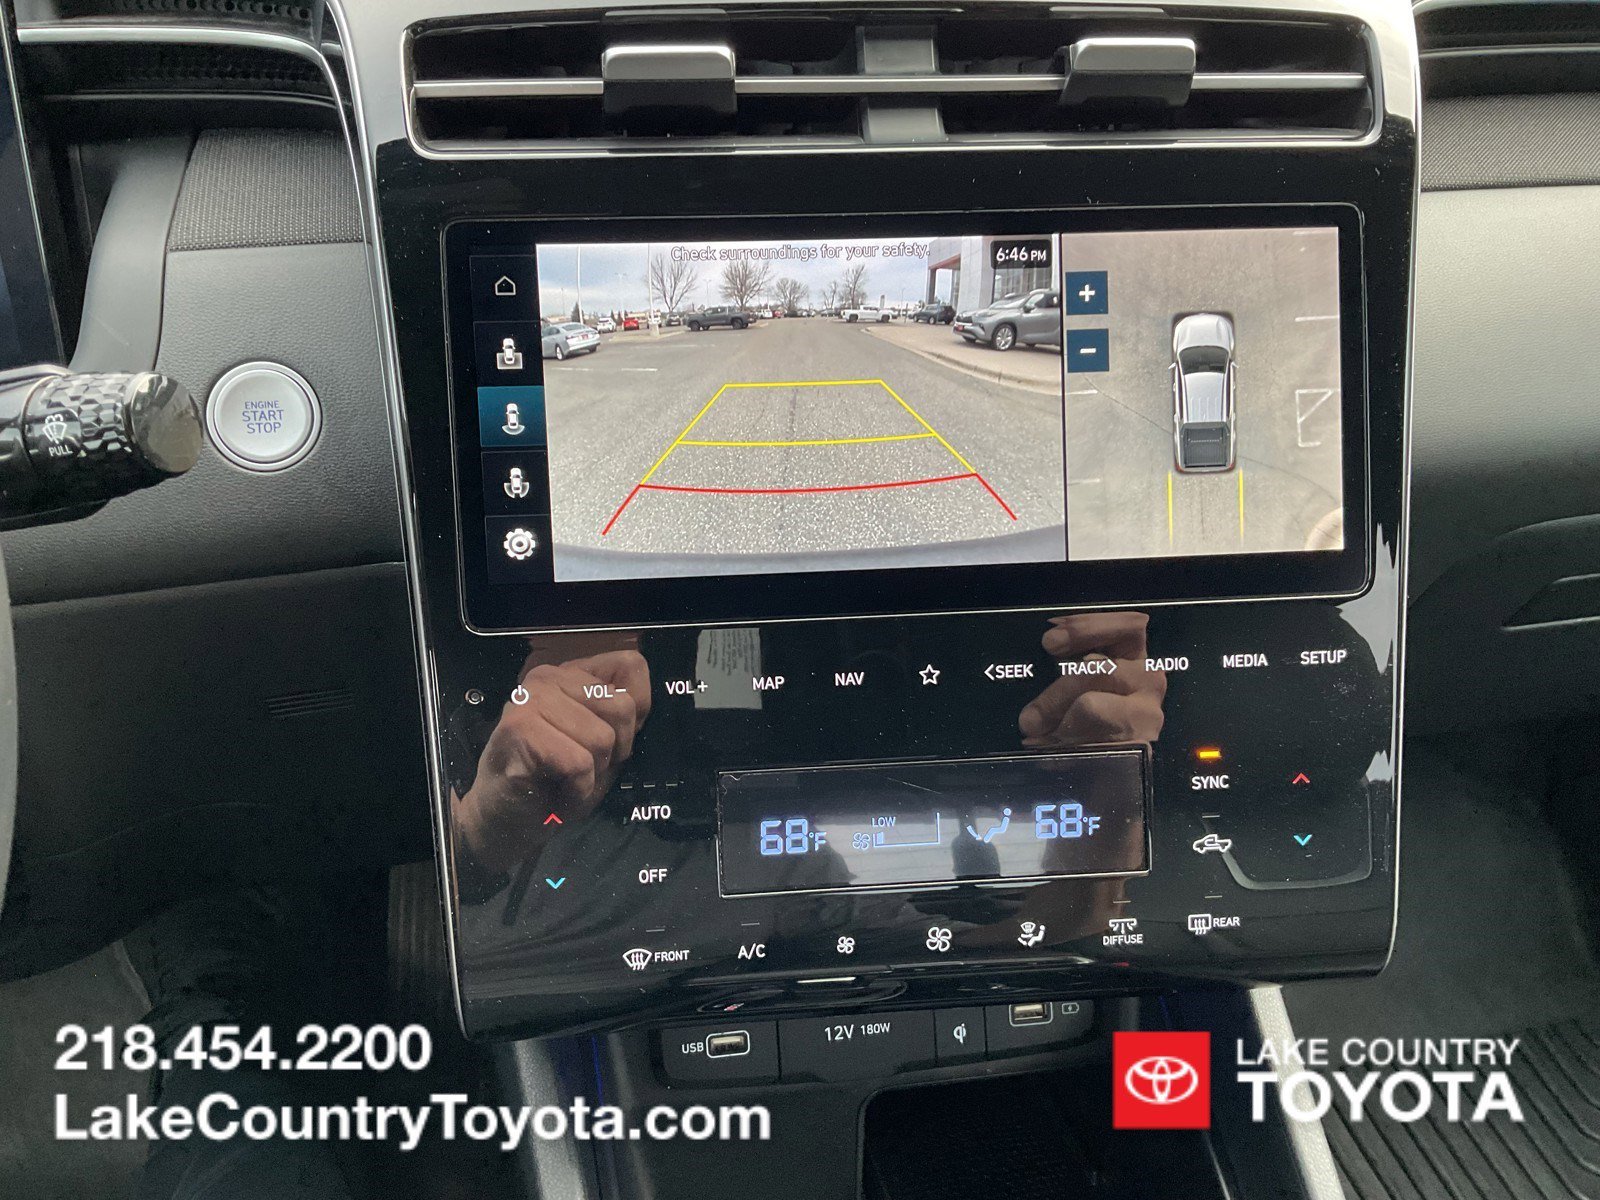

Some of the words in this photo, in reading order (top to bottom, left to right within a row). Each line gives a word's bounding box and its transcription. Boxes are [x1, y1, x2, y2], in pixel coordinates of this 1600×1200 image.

[671, 246, 717, 262] Check
[719, 245, 818, 264] surroundings
[820, 243, 842, 260] for
[845, 244, 878, 262] your
[881, 242, 931, 261] safety.
[996, 246, 1028, 262] 6:46
[1030, 249, 1047, 262] PM
[244, 400, 280, 409] ENGINE
[242, 410, 284, 422] START
[246, 421, 282, 433] STOP
[49, 445, 73, 457] PULL
[1145, 657, 1189, 672] RADIO
[1222, 654, 1268, 669] MEDIA
[1300, 649, 1346, 665] SETUP
[752, 676, 785, 691] MAP
[834, 671, 865, 687] NAV
[1191, 775, 1230, 791] SYNC
[630, 805, 672, 821] AUTO
[871, 816, 896, 829] LOW
[638, 868, 667, 884] OFF
[1213, 915, 1241, 928] REAR
[1102, 933, 1144, 946] DIFFUSE
[654, 949, 690, 963] FRONT
[737, 943, 766, 960] A/C
[824, 1024, 854, 1042] 12V
[860, 1022, 891, 1036] 180W
[681, 1042, 704, 1054] USB
